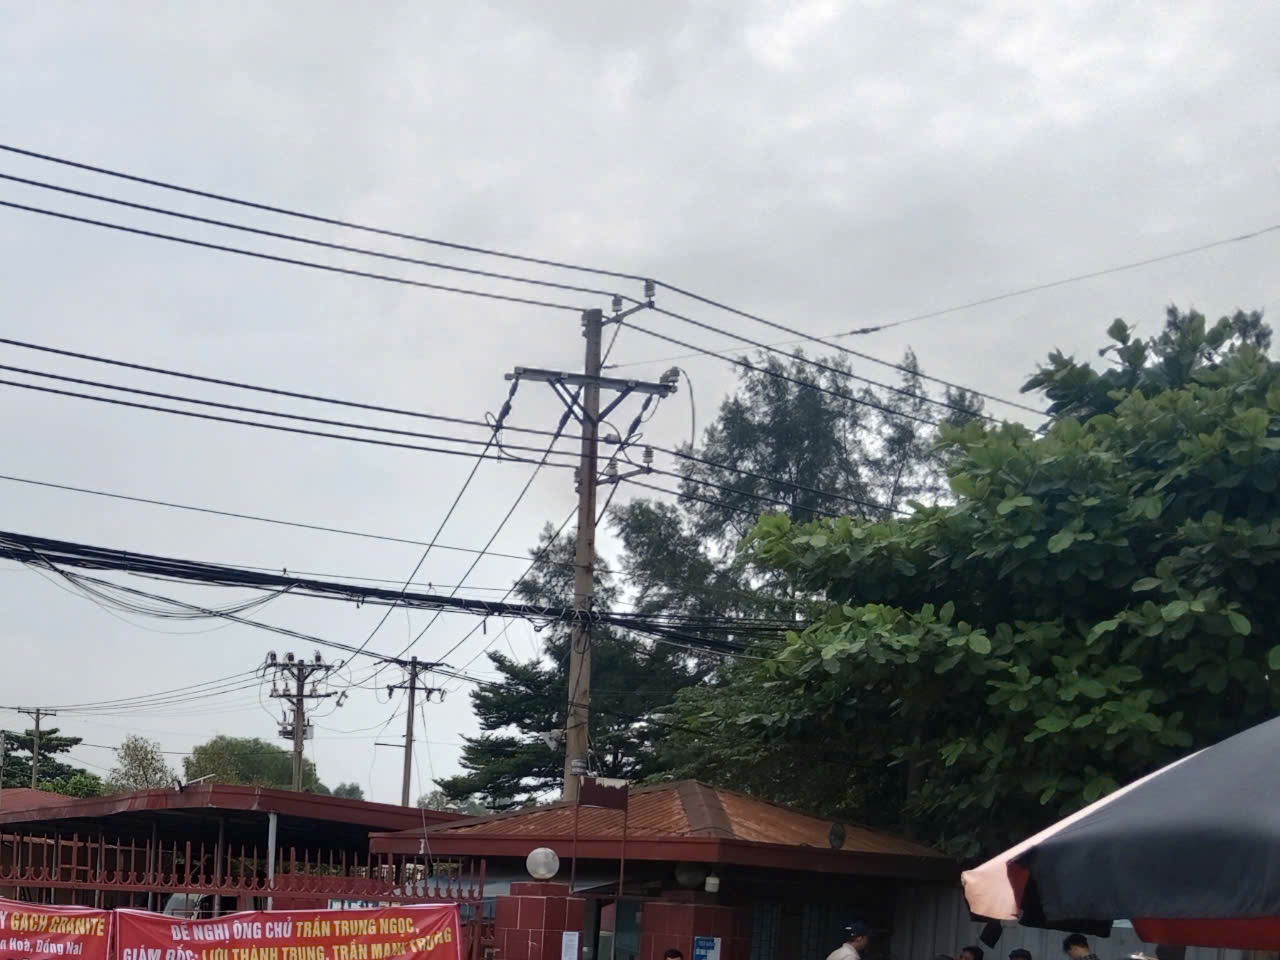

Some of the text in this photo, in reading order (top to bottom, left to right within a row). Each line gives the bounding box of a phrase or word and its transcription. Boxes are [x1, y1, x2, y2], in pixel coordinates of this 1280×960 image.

[10, 911, 48, 935] GẠCH
[48, 916, 105, 937] GRANITE
[172, 915, 420, 944] ĐỀ NGHỊ ÔNG CHỦ TRẦN TRUNG NGỌC,
[35, 937, 64, 956] Đồng
[65, 942, 84, 956] Nai
